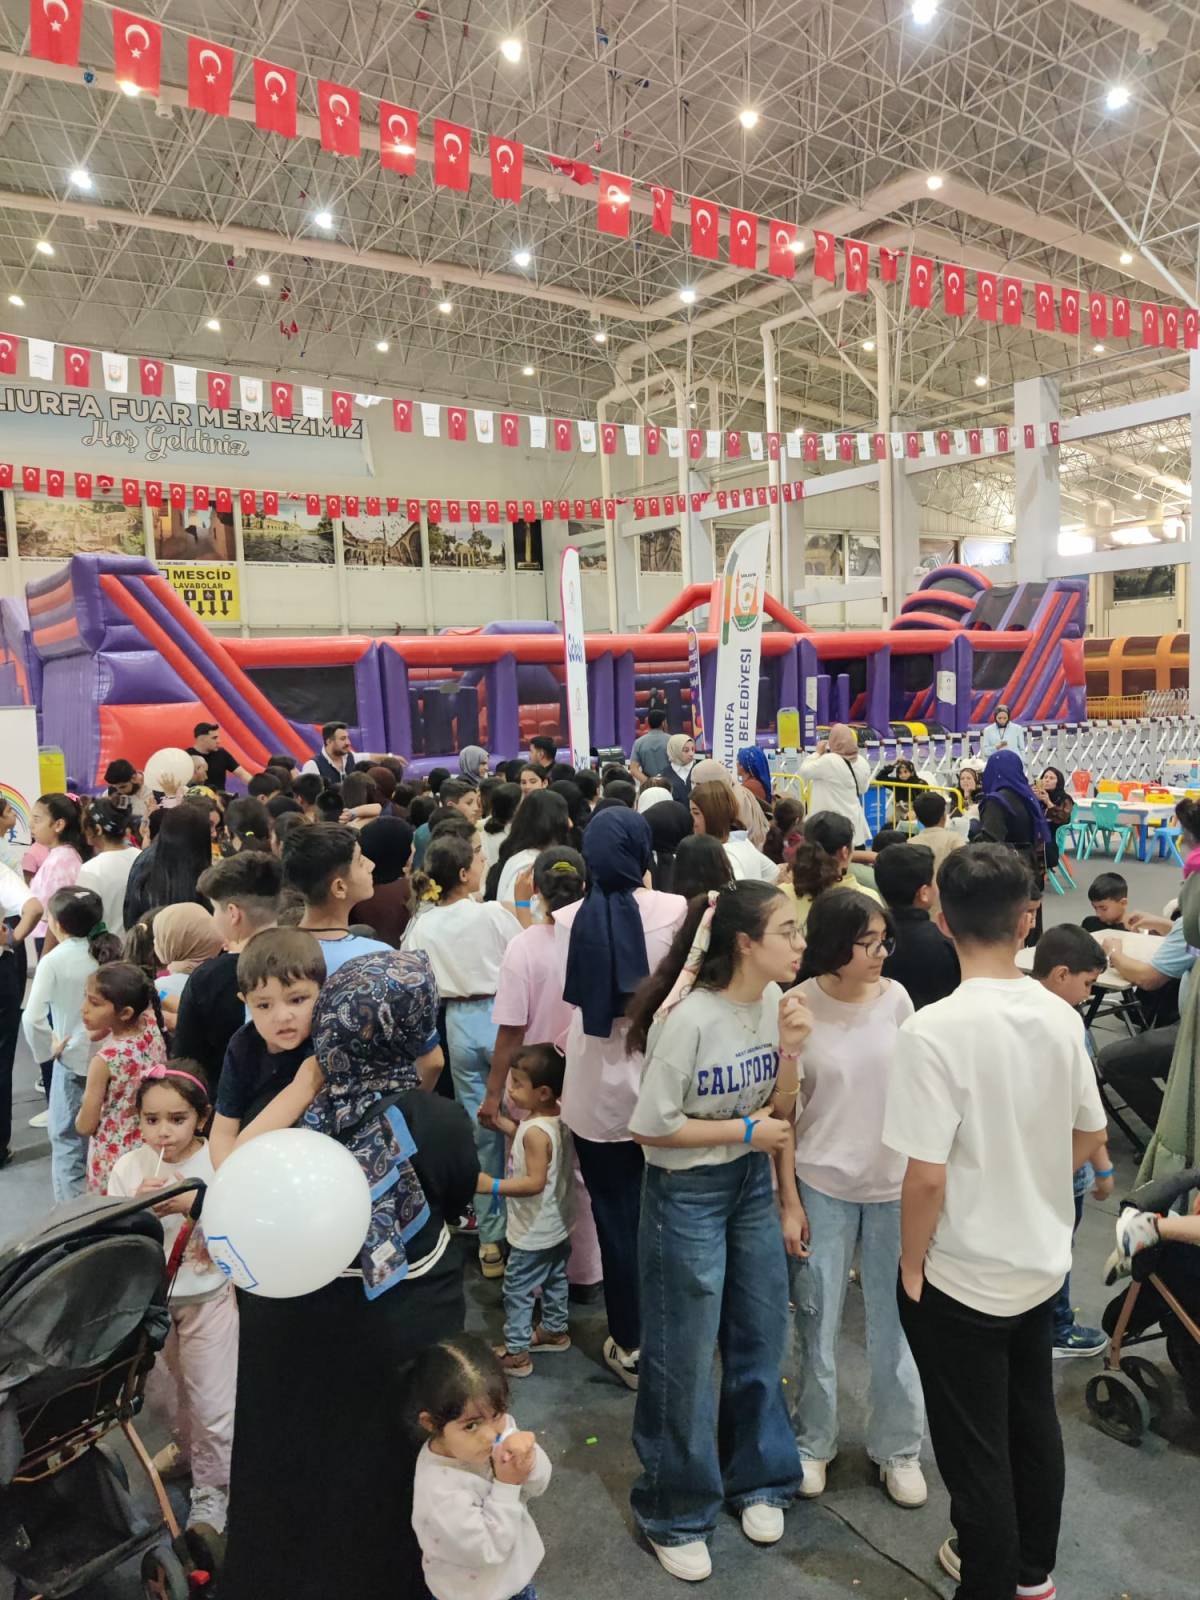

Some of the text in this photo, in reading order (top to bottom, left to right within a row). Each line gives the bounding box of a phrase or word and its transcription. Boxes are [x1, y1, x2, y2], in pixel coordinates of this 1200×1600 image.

[110, 397, 193, 426] FUAR
[81, 420, 249, 461] Hoş Geldiniz
[173, 568, 232, 580] MESCİD
[173, 582, 224, 590] LAVABOLAR
[724, 702, 735, 773] NLIURFA
